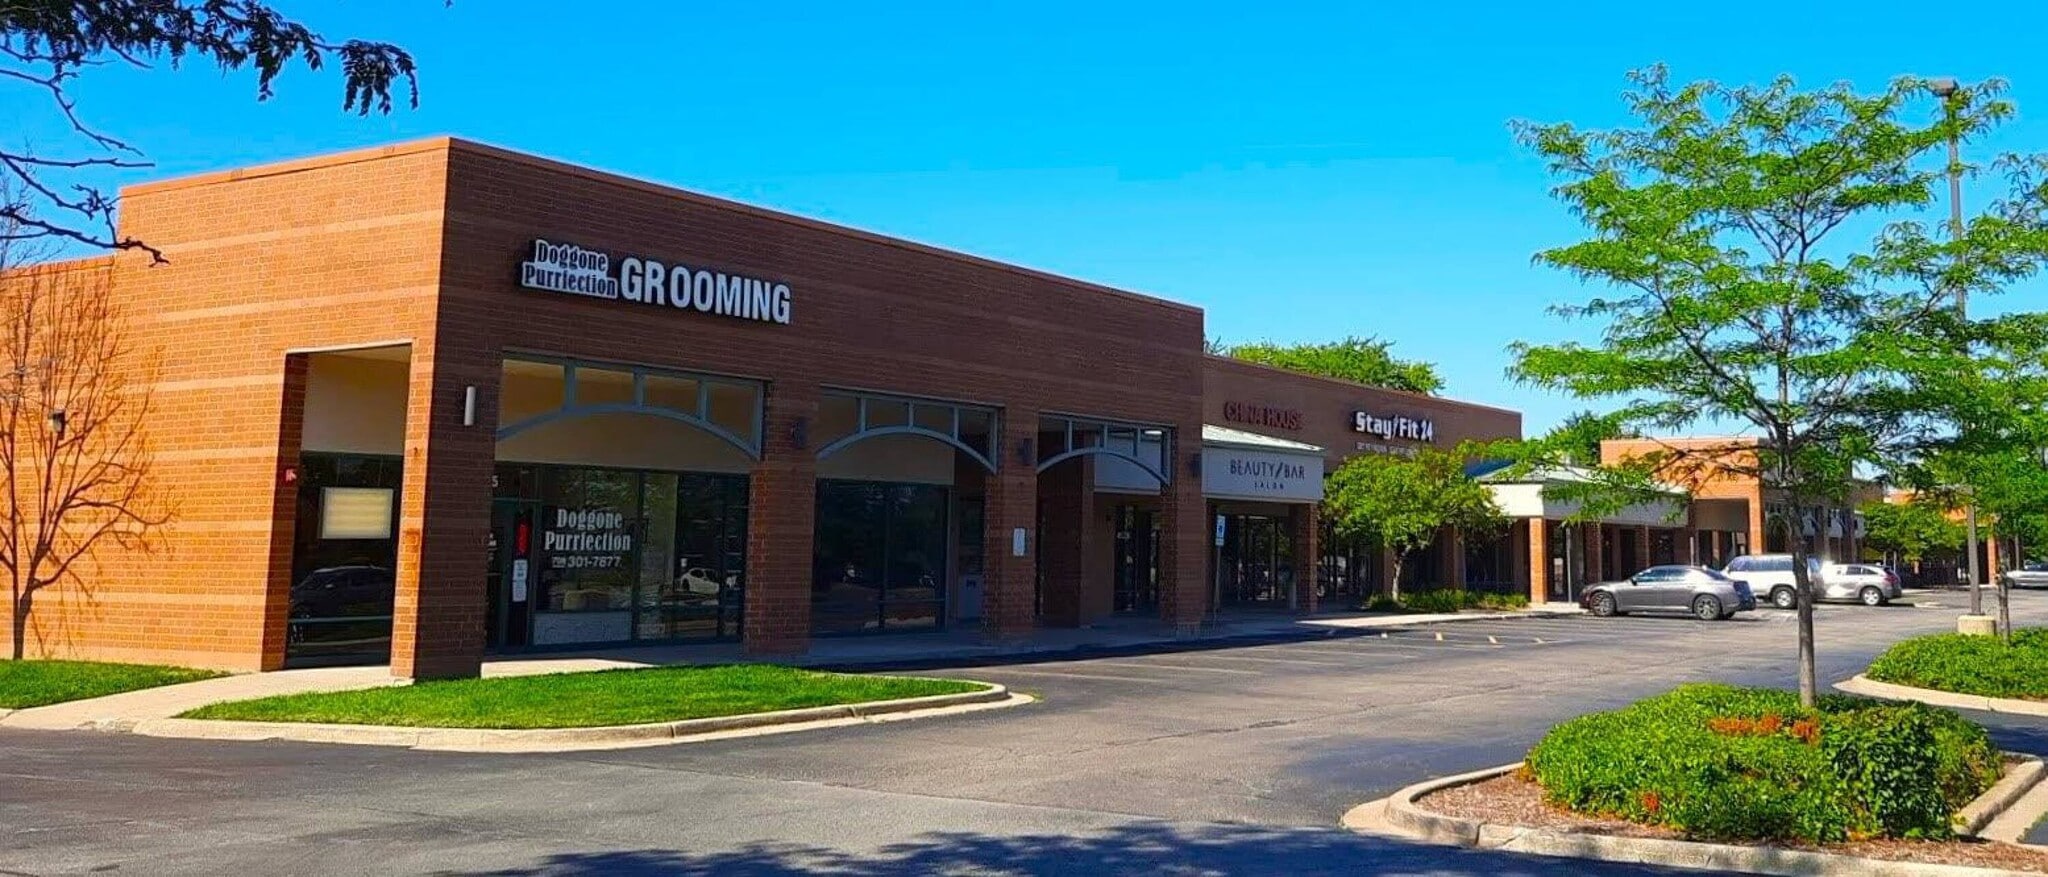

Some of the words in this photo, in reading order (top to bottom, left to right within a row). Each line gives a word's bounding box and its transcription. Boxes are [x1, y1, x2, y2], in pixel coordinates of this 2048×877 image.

[536, 242, 607, 272] Doggone
[523, 264, 617, 297] Purrfection
[620, 257, 791, 324] GROOMING
[1262, 407, 1304, 430] HOUSE
[1420, 419, 1433, 442] 24
[557, 509, 622, 530] Doggone
[545, 531, 631, 551] Purrfection
